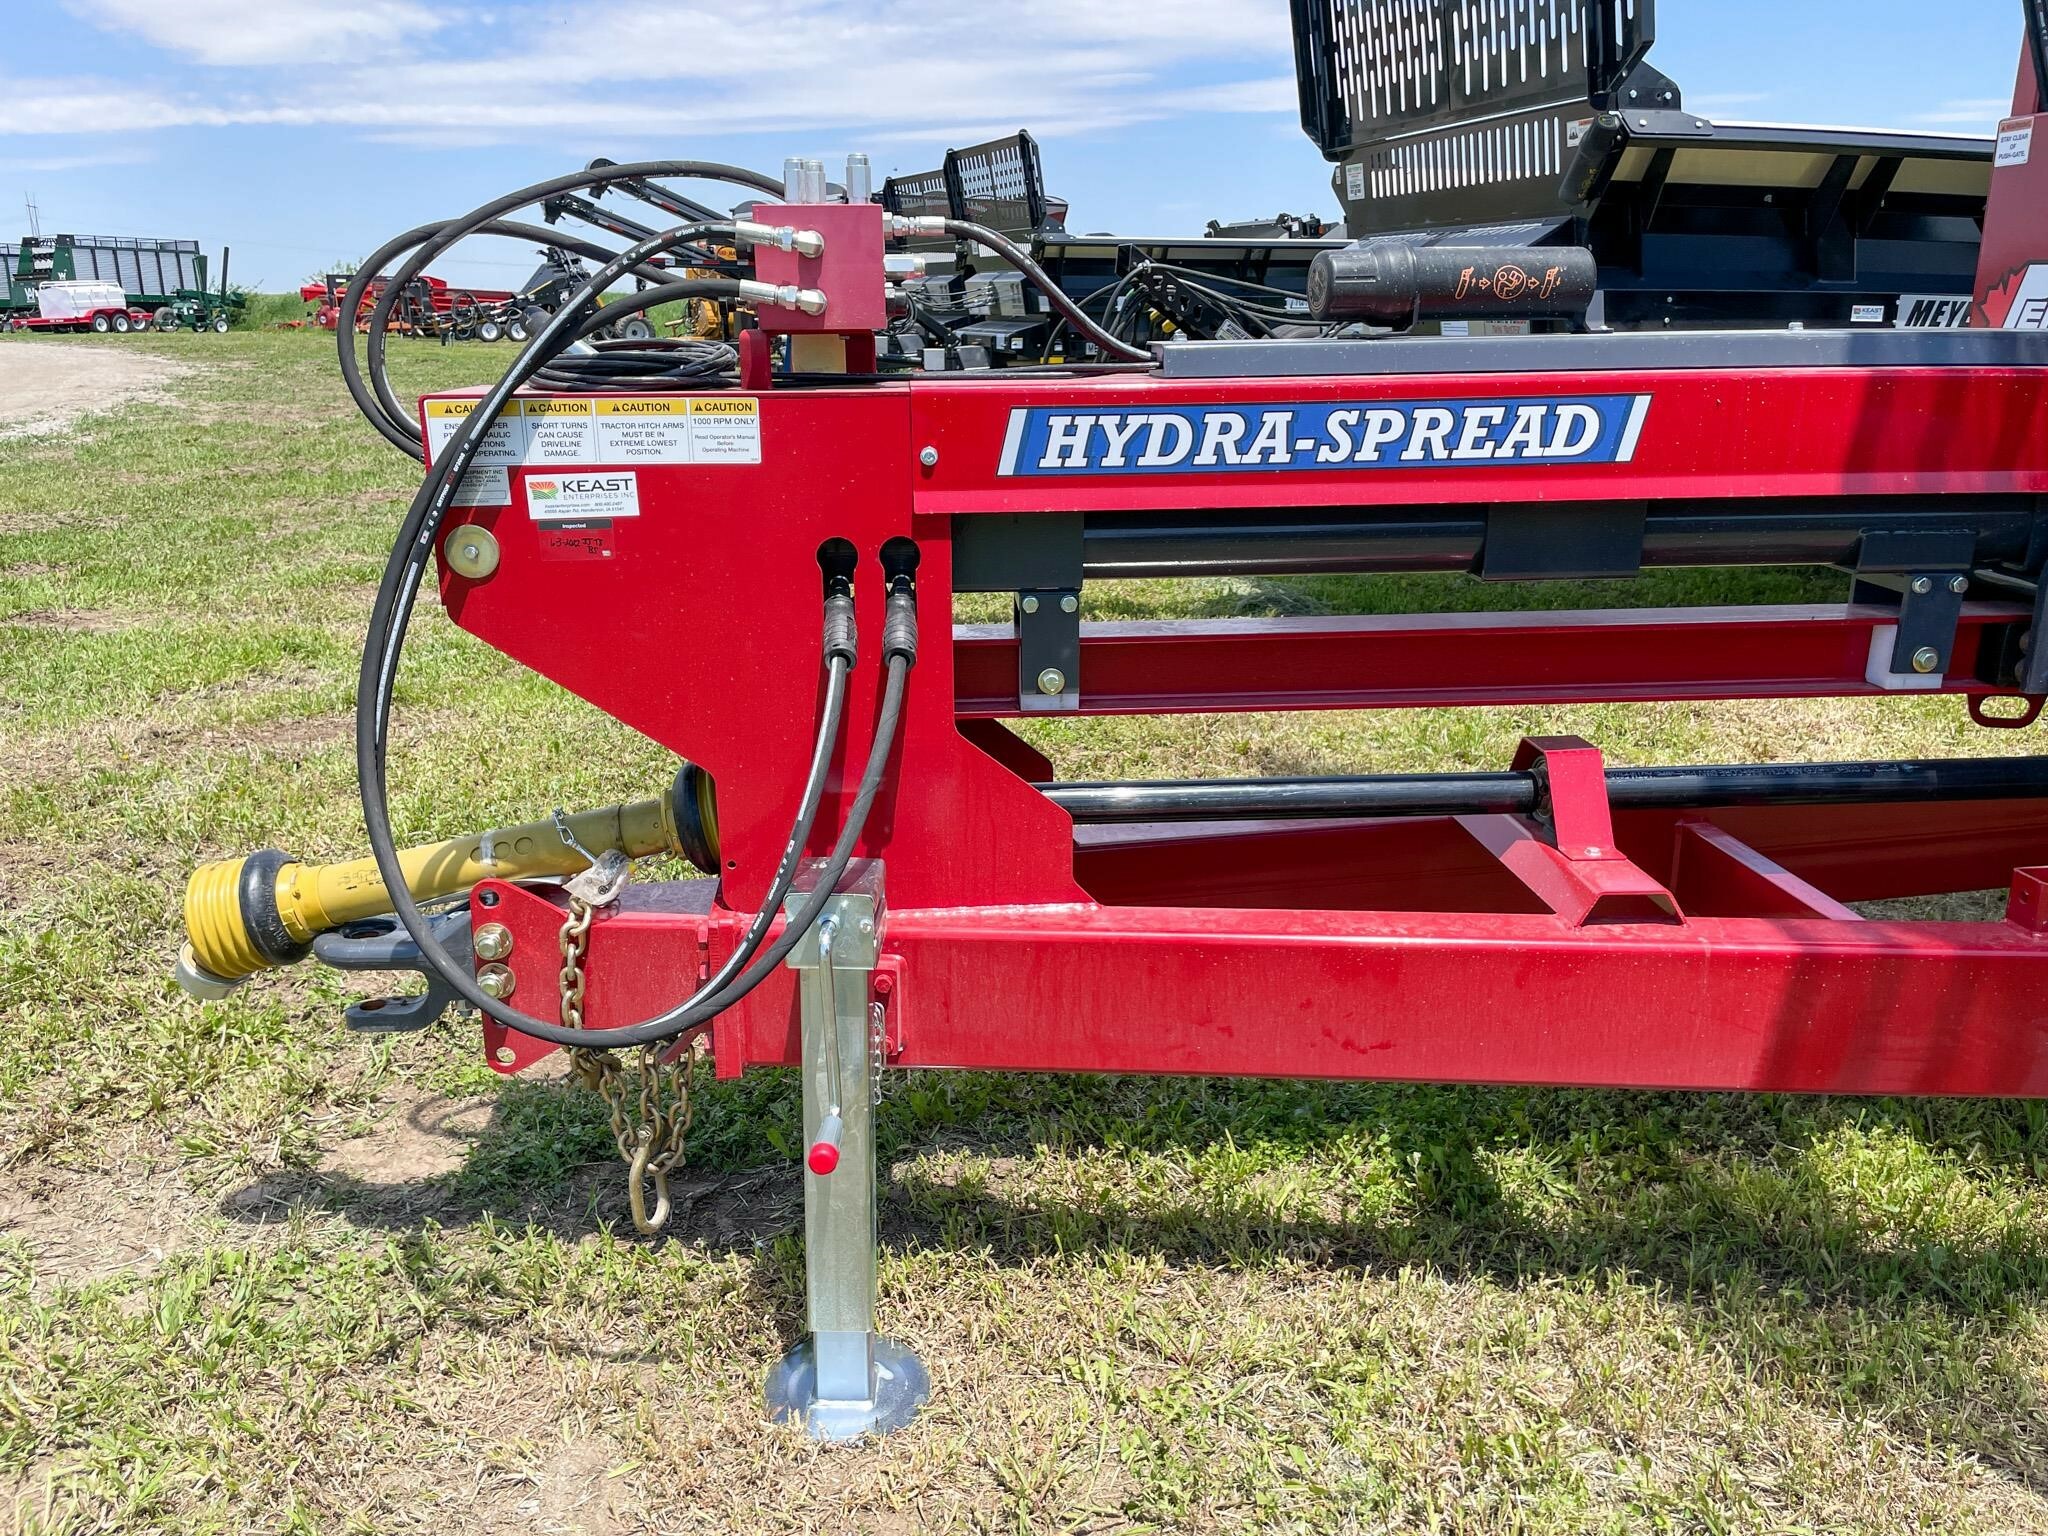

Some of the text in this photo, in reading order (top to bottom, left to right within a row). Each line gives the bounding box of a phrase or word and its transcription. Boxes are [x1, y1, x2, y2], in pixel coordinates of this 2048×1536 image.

[538, 403, 588, 413] CAUTION
[622, 403, 671, 412] CAUTION
[704, 402, 752, 412] CAUTION
[531, 421, 588, 430] SHORT TURNS
[601, 422, 637, 430] TRACTOR
[662, 421, 685, 429] ARMS
[537, 431, 555, 439] CAN
[709, 433, 736, 441] Operator's
[1037, 404, 1600, 468] HYDRA-SPREAD
[541, 440, 582, 448] DRIVELINE
[646, 439, 678, 447] LOWEST
[544, 449, 581, 457] DAMAGE.
[626, 448, 663, 456] POSITION.
[562, 479, 633, 493] KEAST
[563, 490, 635, 501] ENTERPRISES INC
